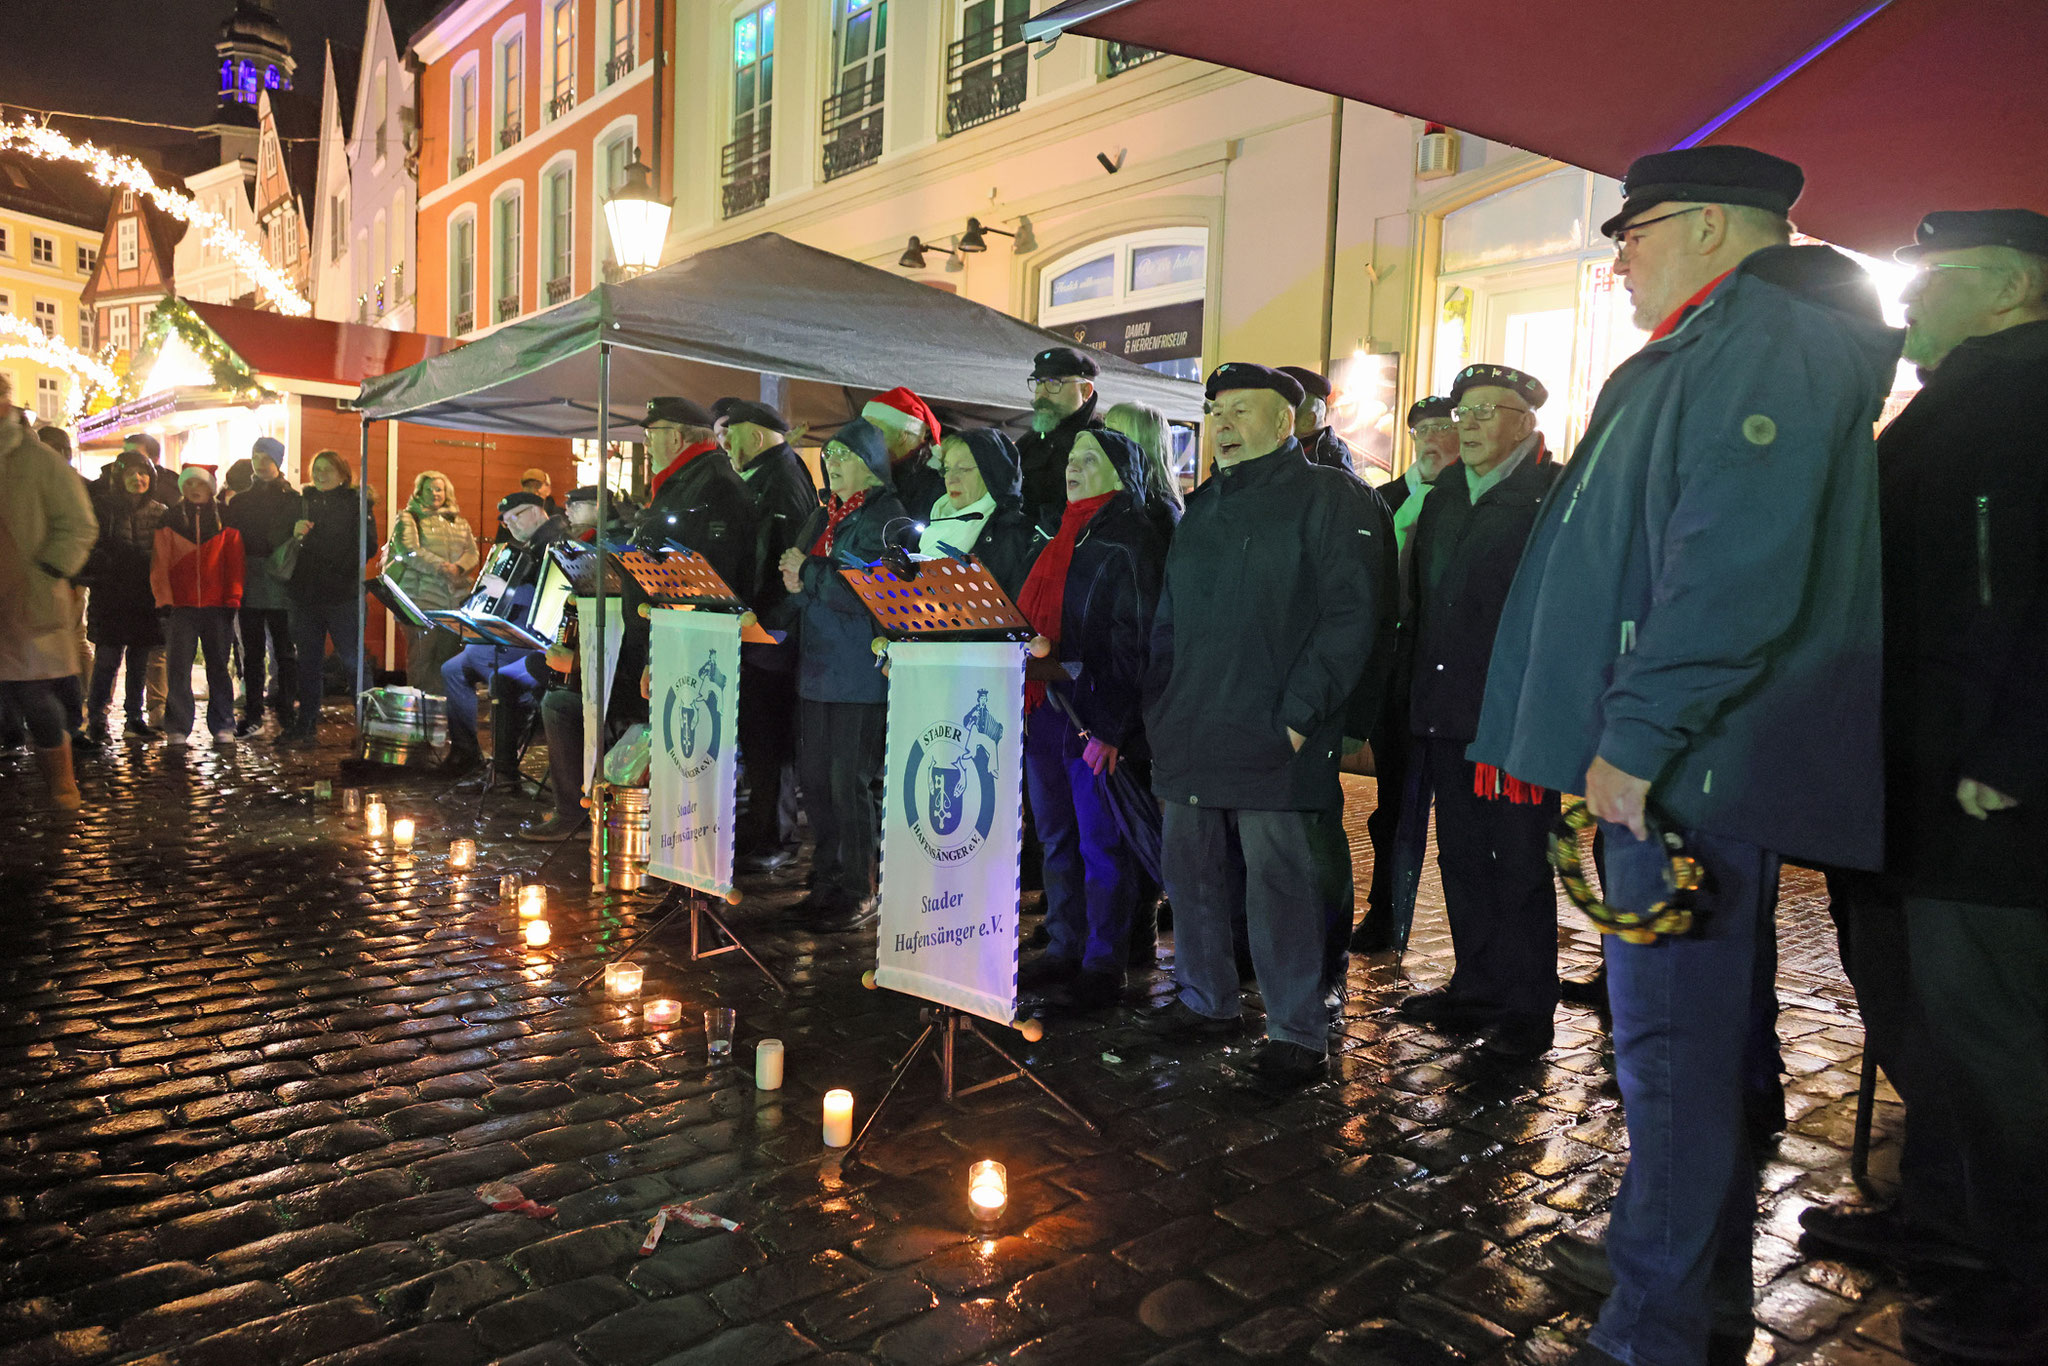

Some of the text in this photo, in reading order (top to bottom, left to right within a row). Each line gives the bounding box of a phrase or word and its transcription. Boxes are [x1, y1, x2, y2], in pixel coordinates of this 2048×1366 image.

[1125, 322, 1151, 339] DAMEN
[1124, 331, 1188, 354] & HERRENFRISEUR
[923, 726, 962, 746] STADER
[676, 800, 698, 818] Stader
[913, 823, 969, 862] HAFENSÄNGER
[921, 890, 964, 914] Stader
[895, 914, 1003, 954] Hafensänger e.V.
